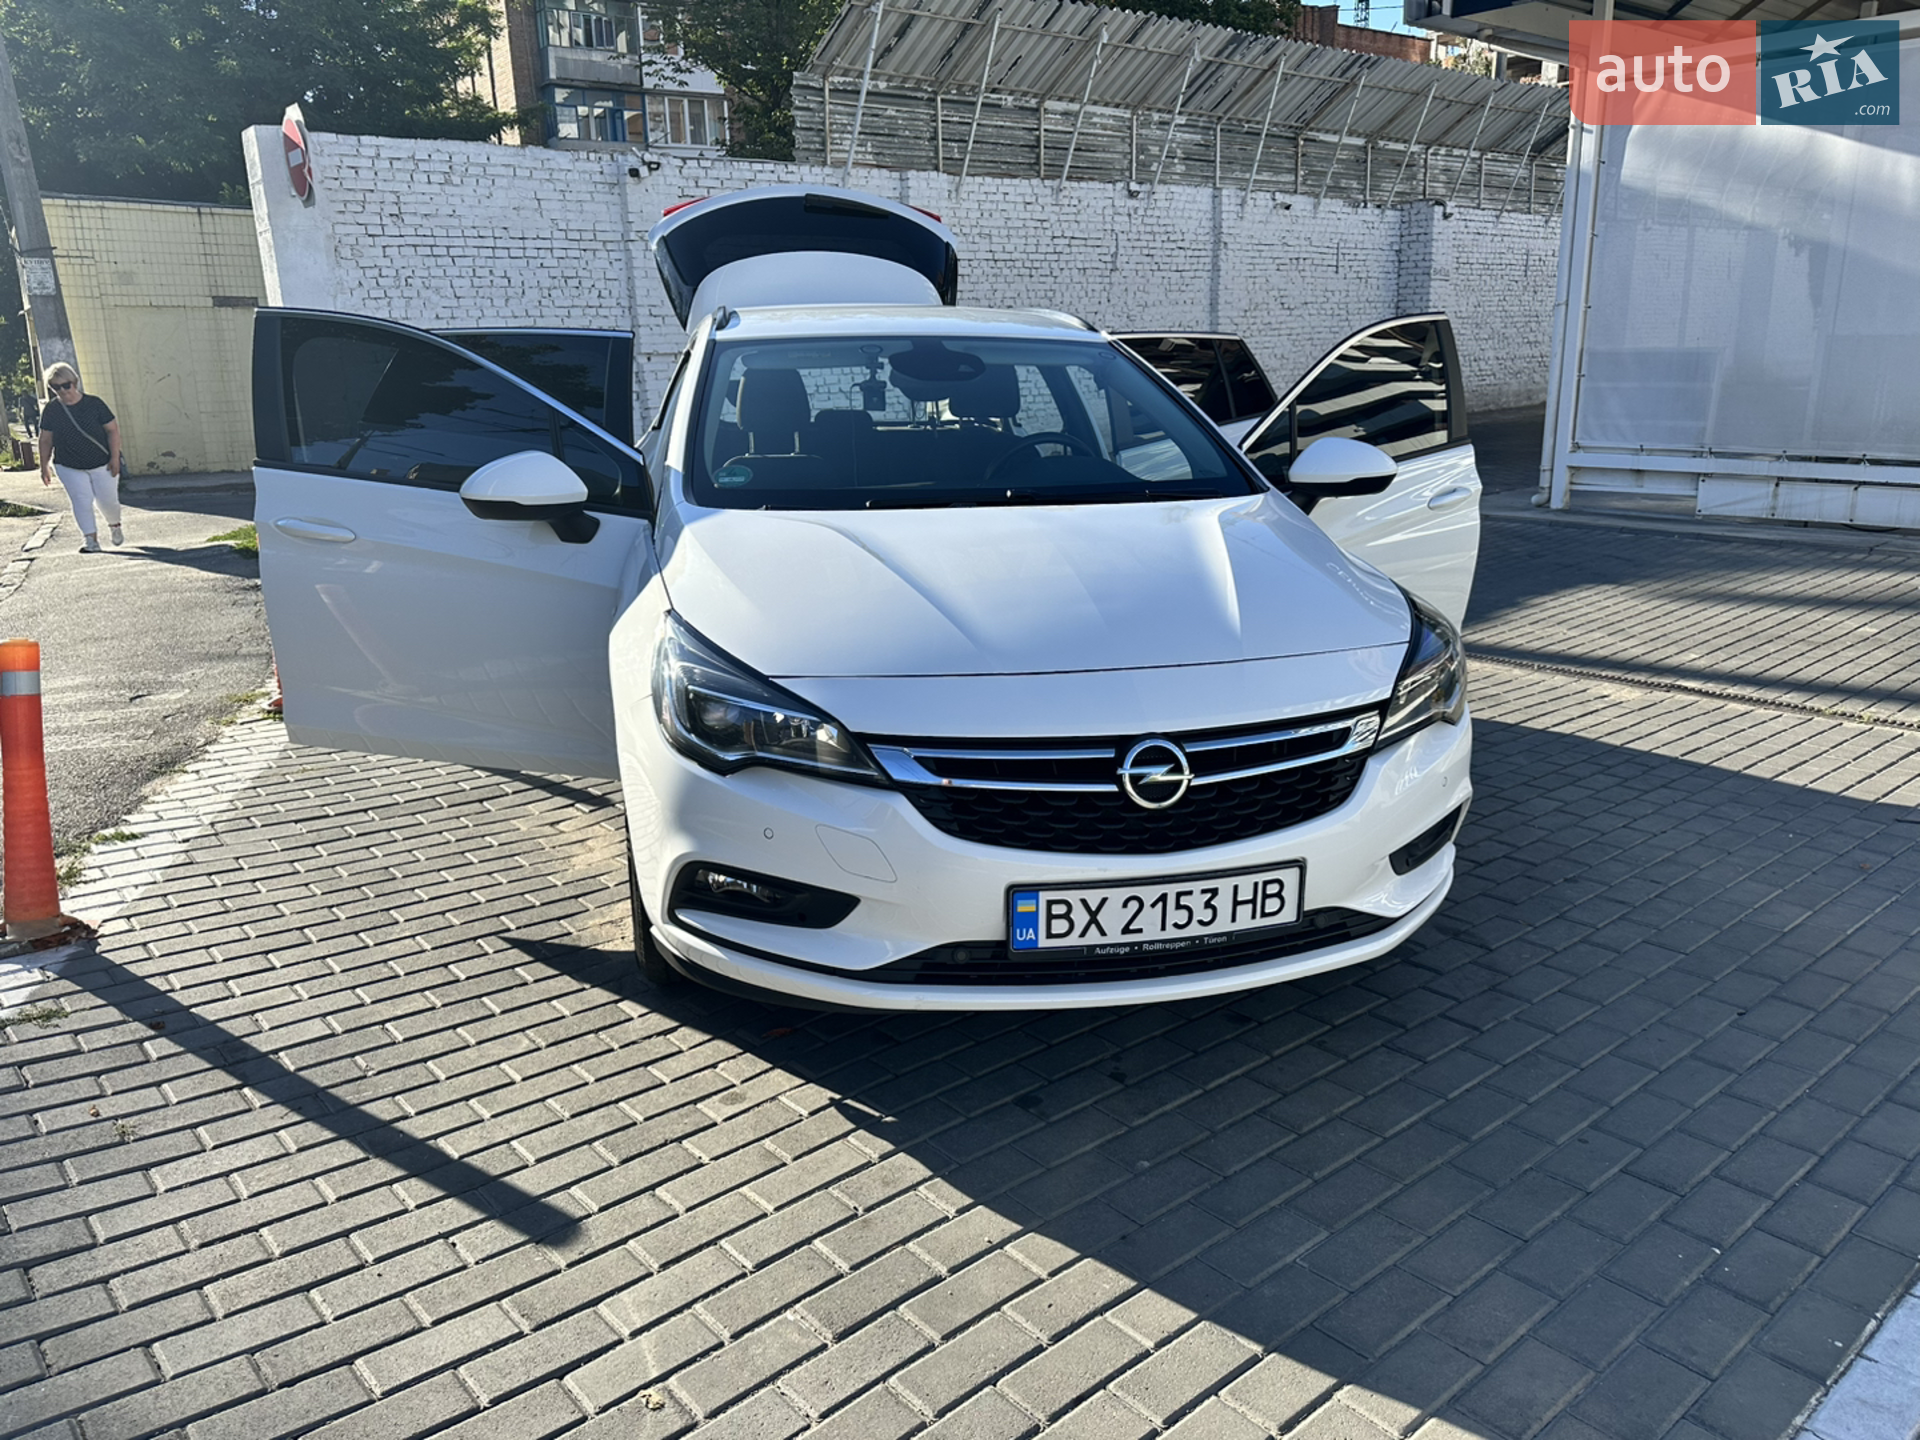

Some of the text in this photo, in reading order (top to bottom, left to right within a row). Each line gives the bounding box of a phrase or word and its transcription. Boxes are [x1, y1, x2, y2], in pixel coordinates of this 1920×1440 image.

[1045, 877, 1286, 940] BX 2153 HB
[1016, 928, 1036, 941] UA
[1094, 945, 1131, 955] Aufzüge
[1142, 939, 1192, 951] Rolltreppen
